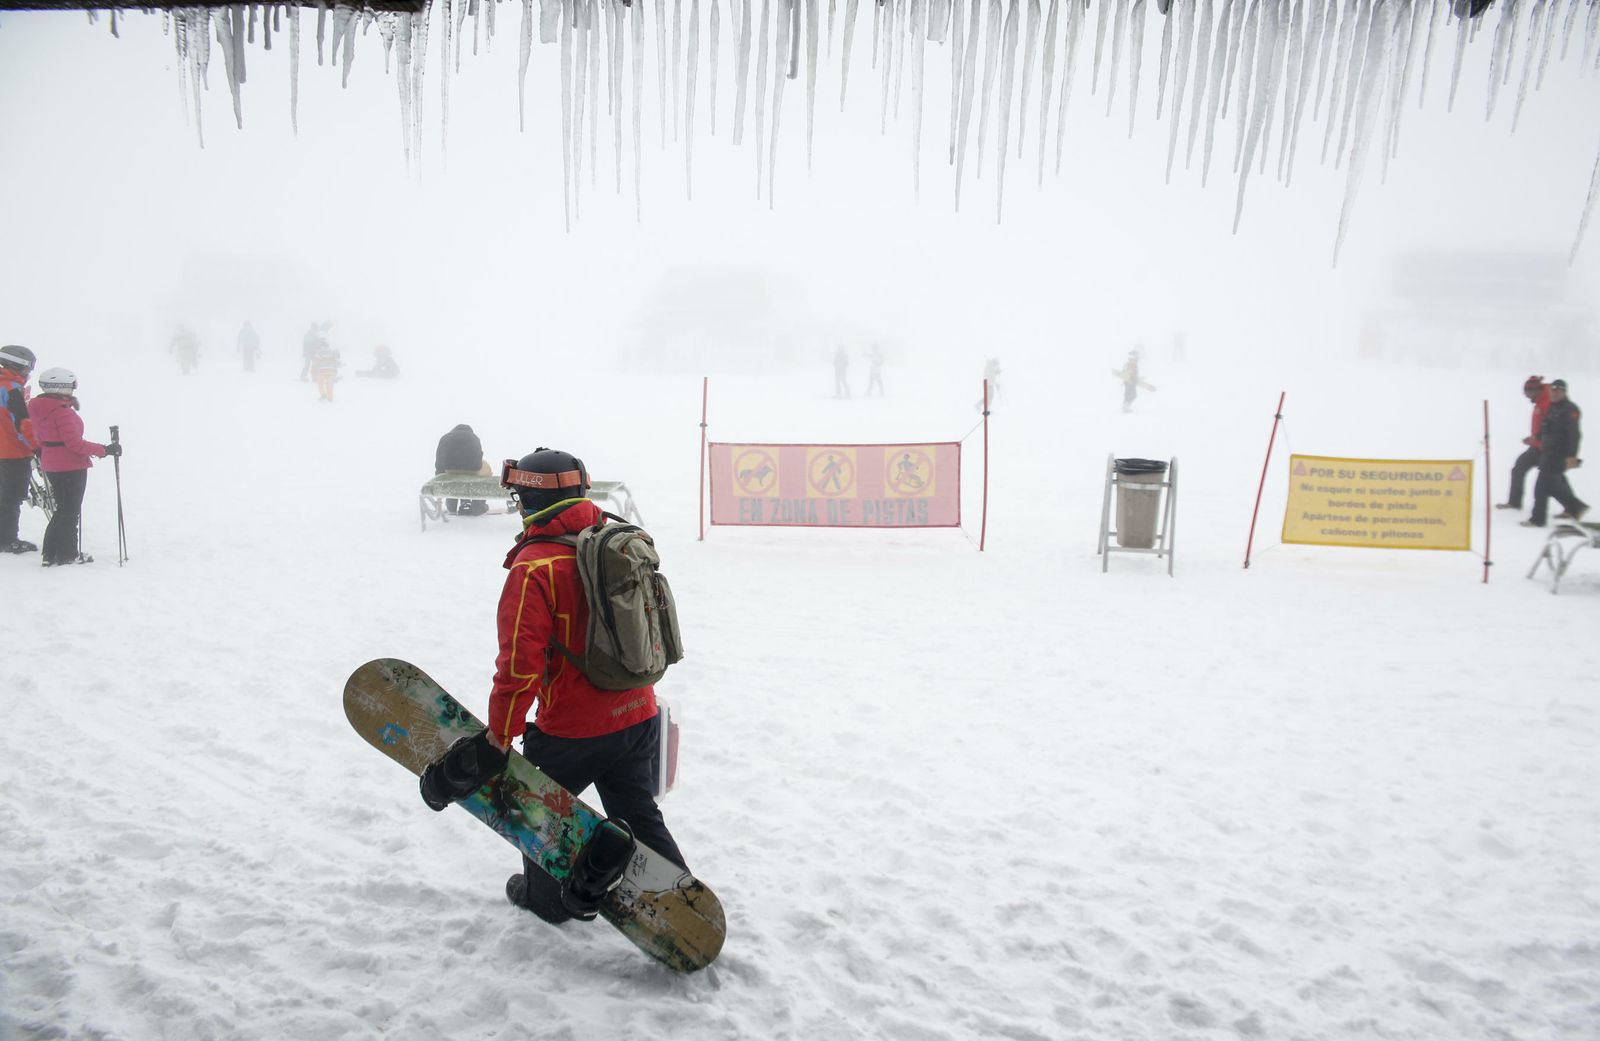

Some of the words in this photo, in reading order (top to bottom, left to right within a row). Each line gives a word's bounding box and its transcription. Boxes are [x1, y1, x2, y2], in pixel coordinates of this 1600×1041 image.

[1310, 467, 1334, 478] POR
[1338, 468, 1356, 479] SU
[1360, 470, 1444, 481] SEGURIDAD
[1300, 483, 1314, 492] No
[1408, 488, 1440, 498] junto
[739, 499, 763, 522] EN
[770, 500, 818, 523] ZONA
[827, 500, 850, 524] DE
[863, 500, 929, 524] PISTAS
[1328, 500, 1366, 509] bordes
[1370, 501, 1383, 510] de
[1387, 501, 1418, 511] pista
[1355, 514, 1368, 523] de
[1321, 526, 1367, 536] cañones
[1371, 530, 1378, 538] y
[1381, 528, 1424, 540] pilonas
